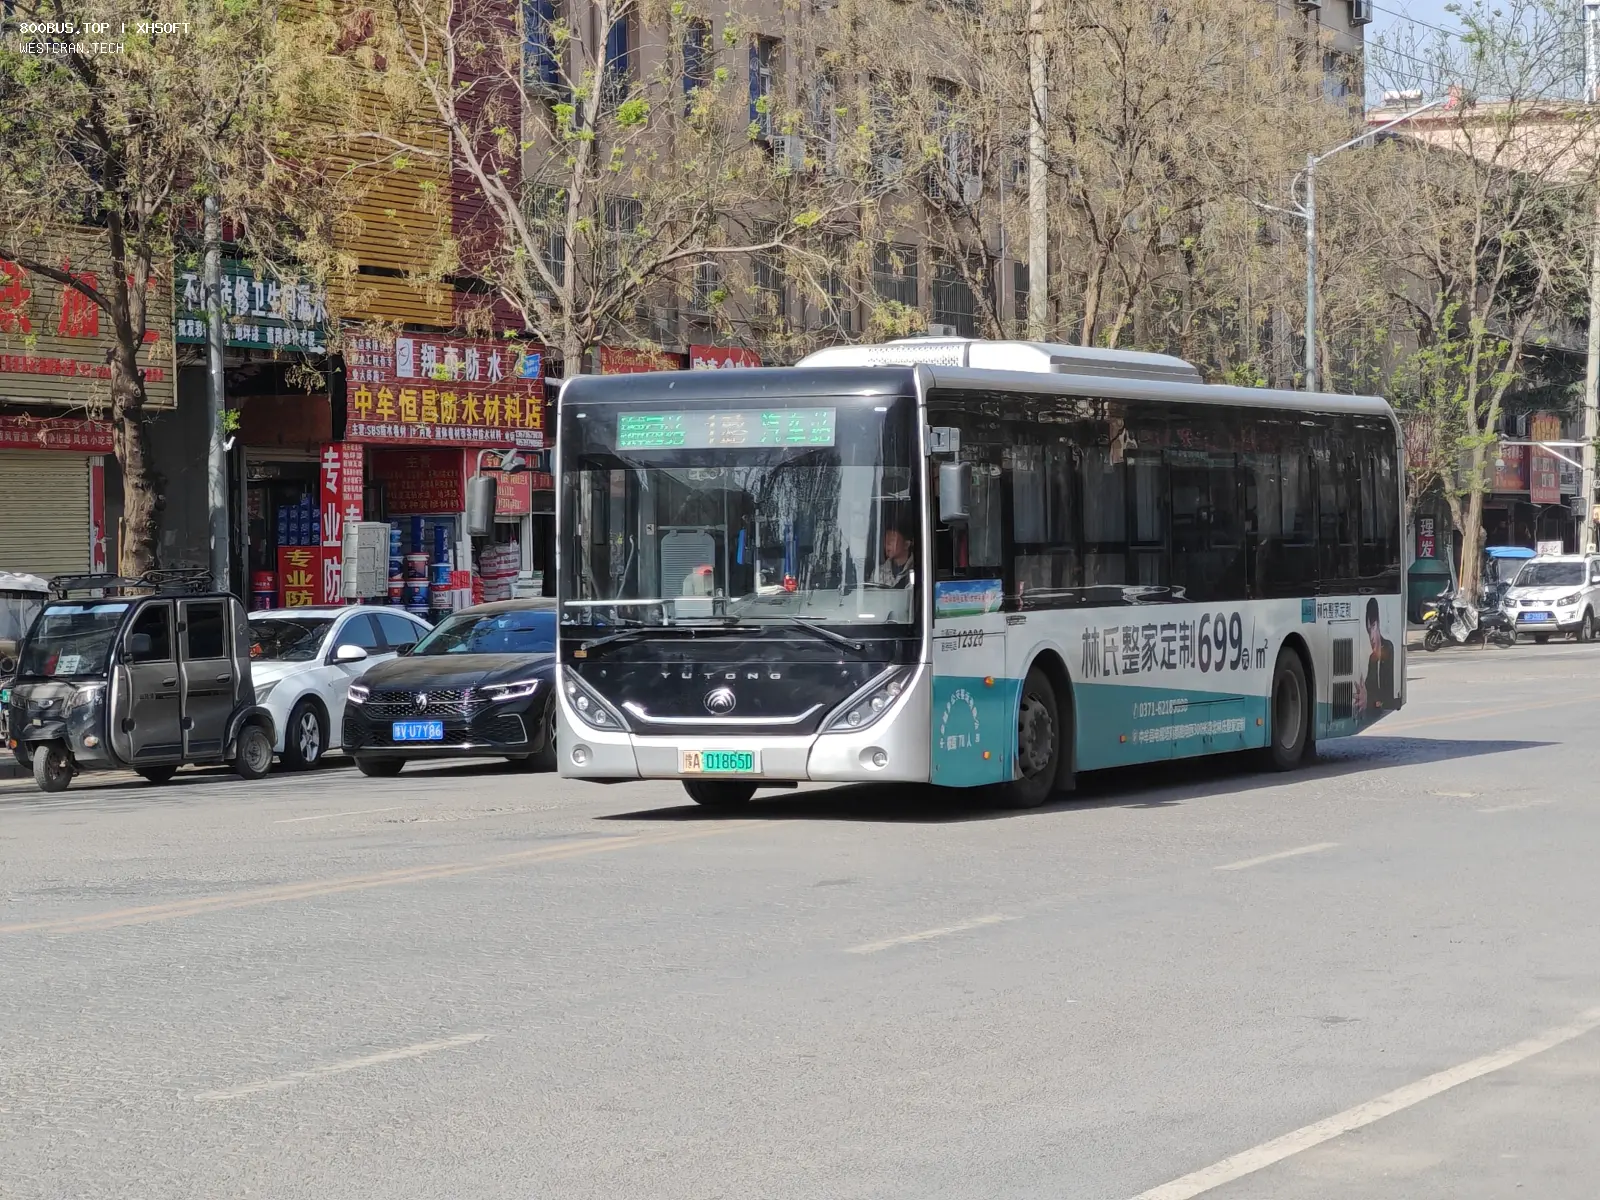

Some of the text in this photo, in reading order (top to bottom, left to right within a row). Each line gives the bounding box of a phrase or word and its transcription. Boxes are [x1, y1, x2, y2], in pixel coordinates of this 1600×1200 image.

[355, 385, 541, 428] 中牟恒昌防水材料店
[1081, 619, 1196, 679] 林氏整家定制
[661, 672, 782, 680] YUTONG
